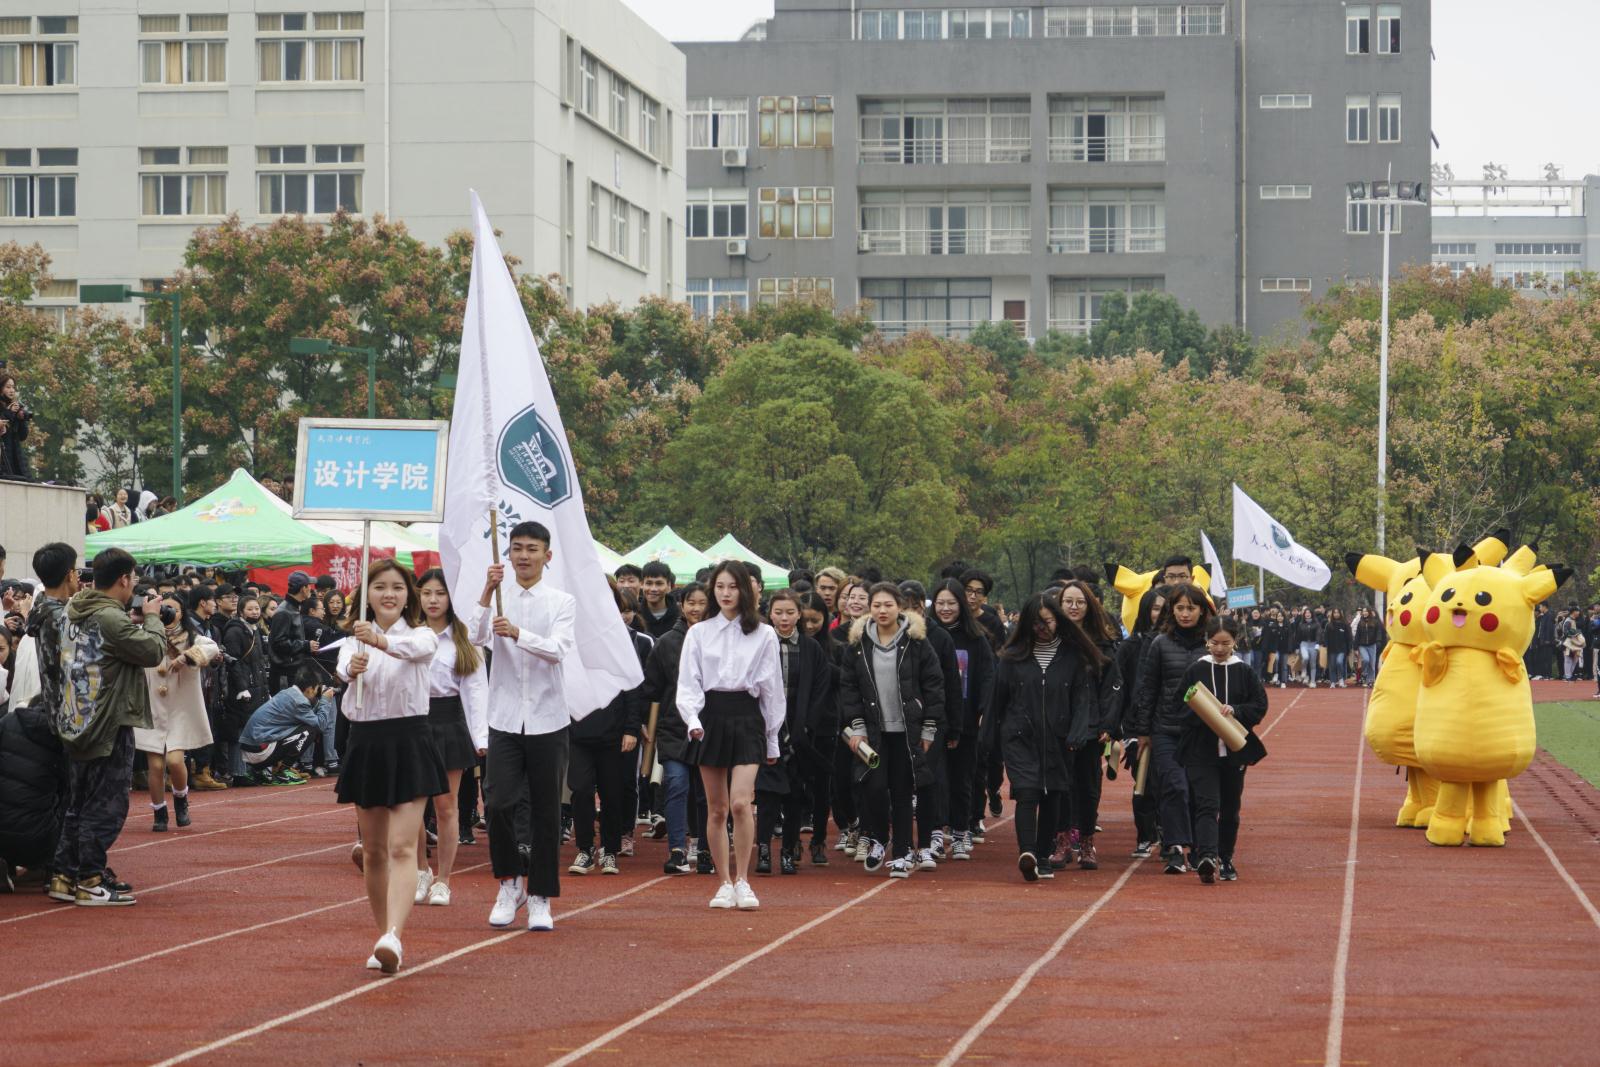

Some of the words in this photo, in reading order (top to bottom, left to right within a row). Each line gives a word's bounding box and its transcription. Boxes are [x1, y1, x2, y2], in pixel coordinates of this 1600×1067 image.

[313, 460, 429, 491] 设计学院
[328, 555, 364, 590] 新闻
